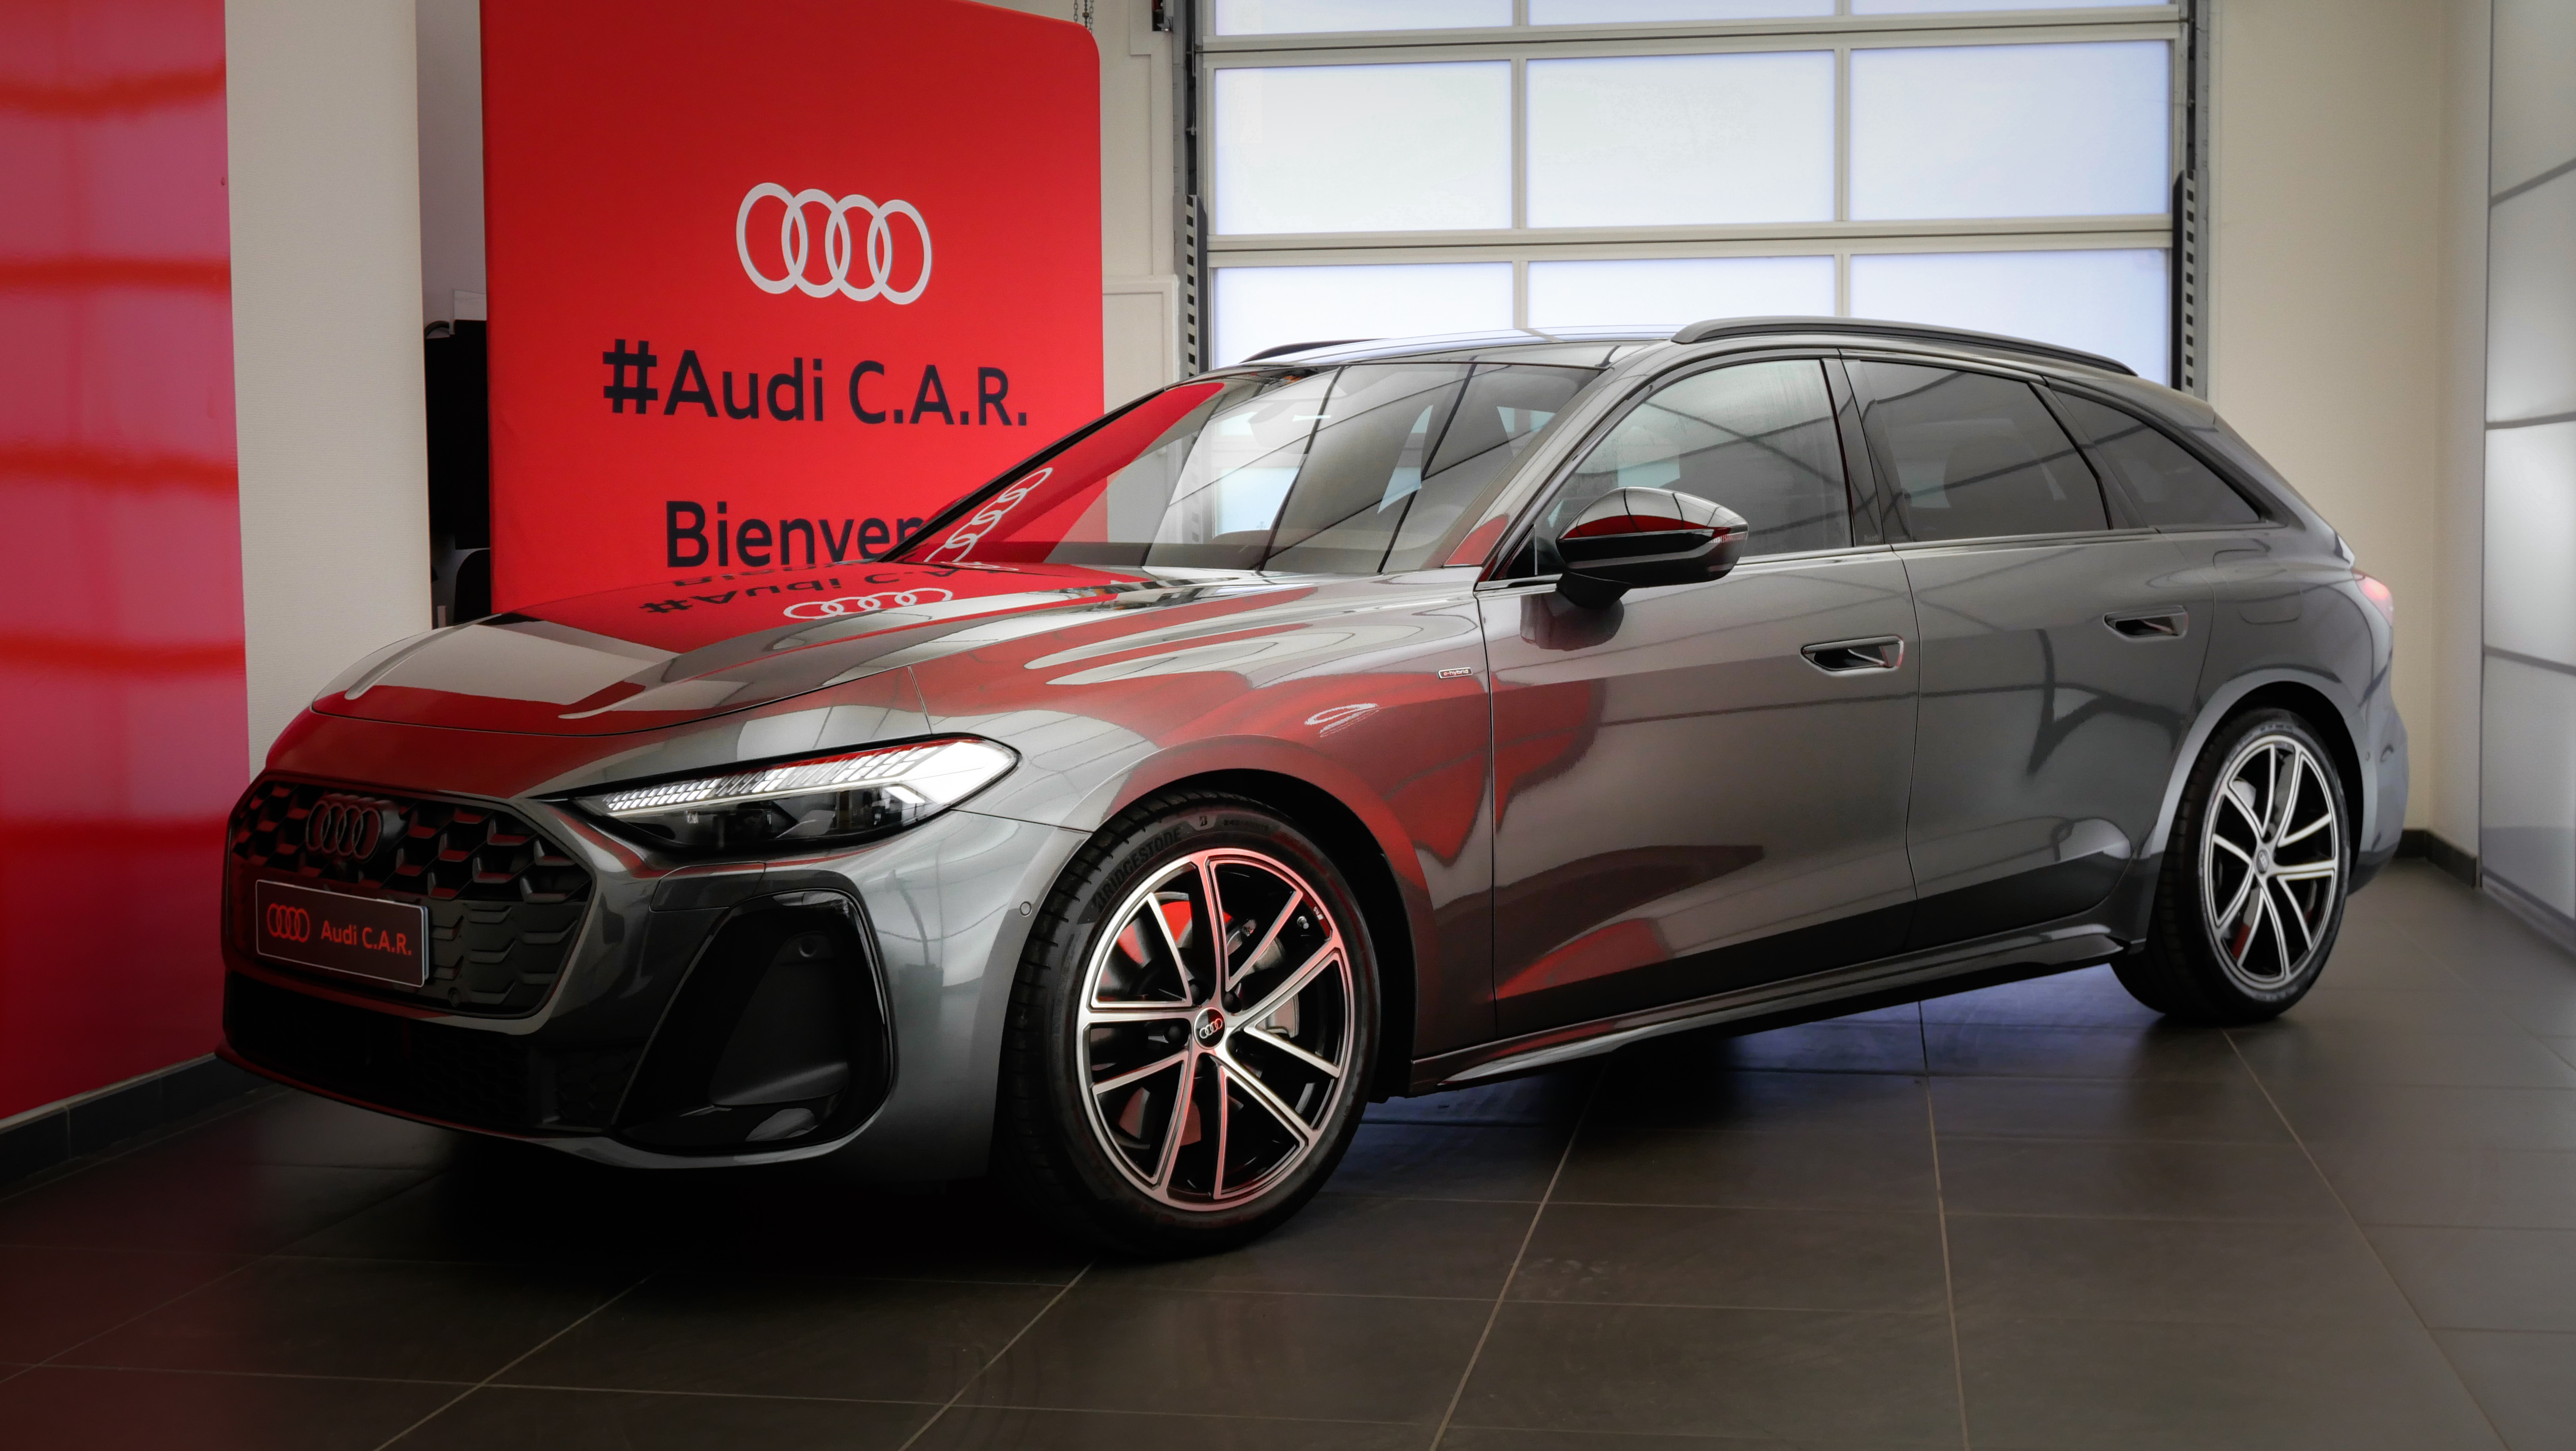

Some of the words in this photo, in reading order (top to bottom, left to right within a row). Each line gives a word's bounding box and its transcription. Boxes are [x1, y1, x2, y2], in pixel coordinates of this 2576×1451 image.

[602, 338, 824, 422] #Audi
[848, 360, 1029, 427] C.A.R.
[1443, 668, 1469, 677] e-hybrid
[1092, 828, 1182, 912] BRIDGESTONE
[321, 920, 358, 946] Audi
[362, 926, 412, 956] C.A.R.
